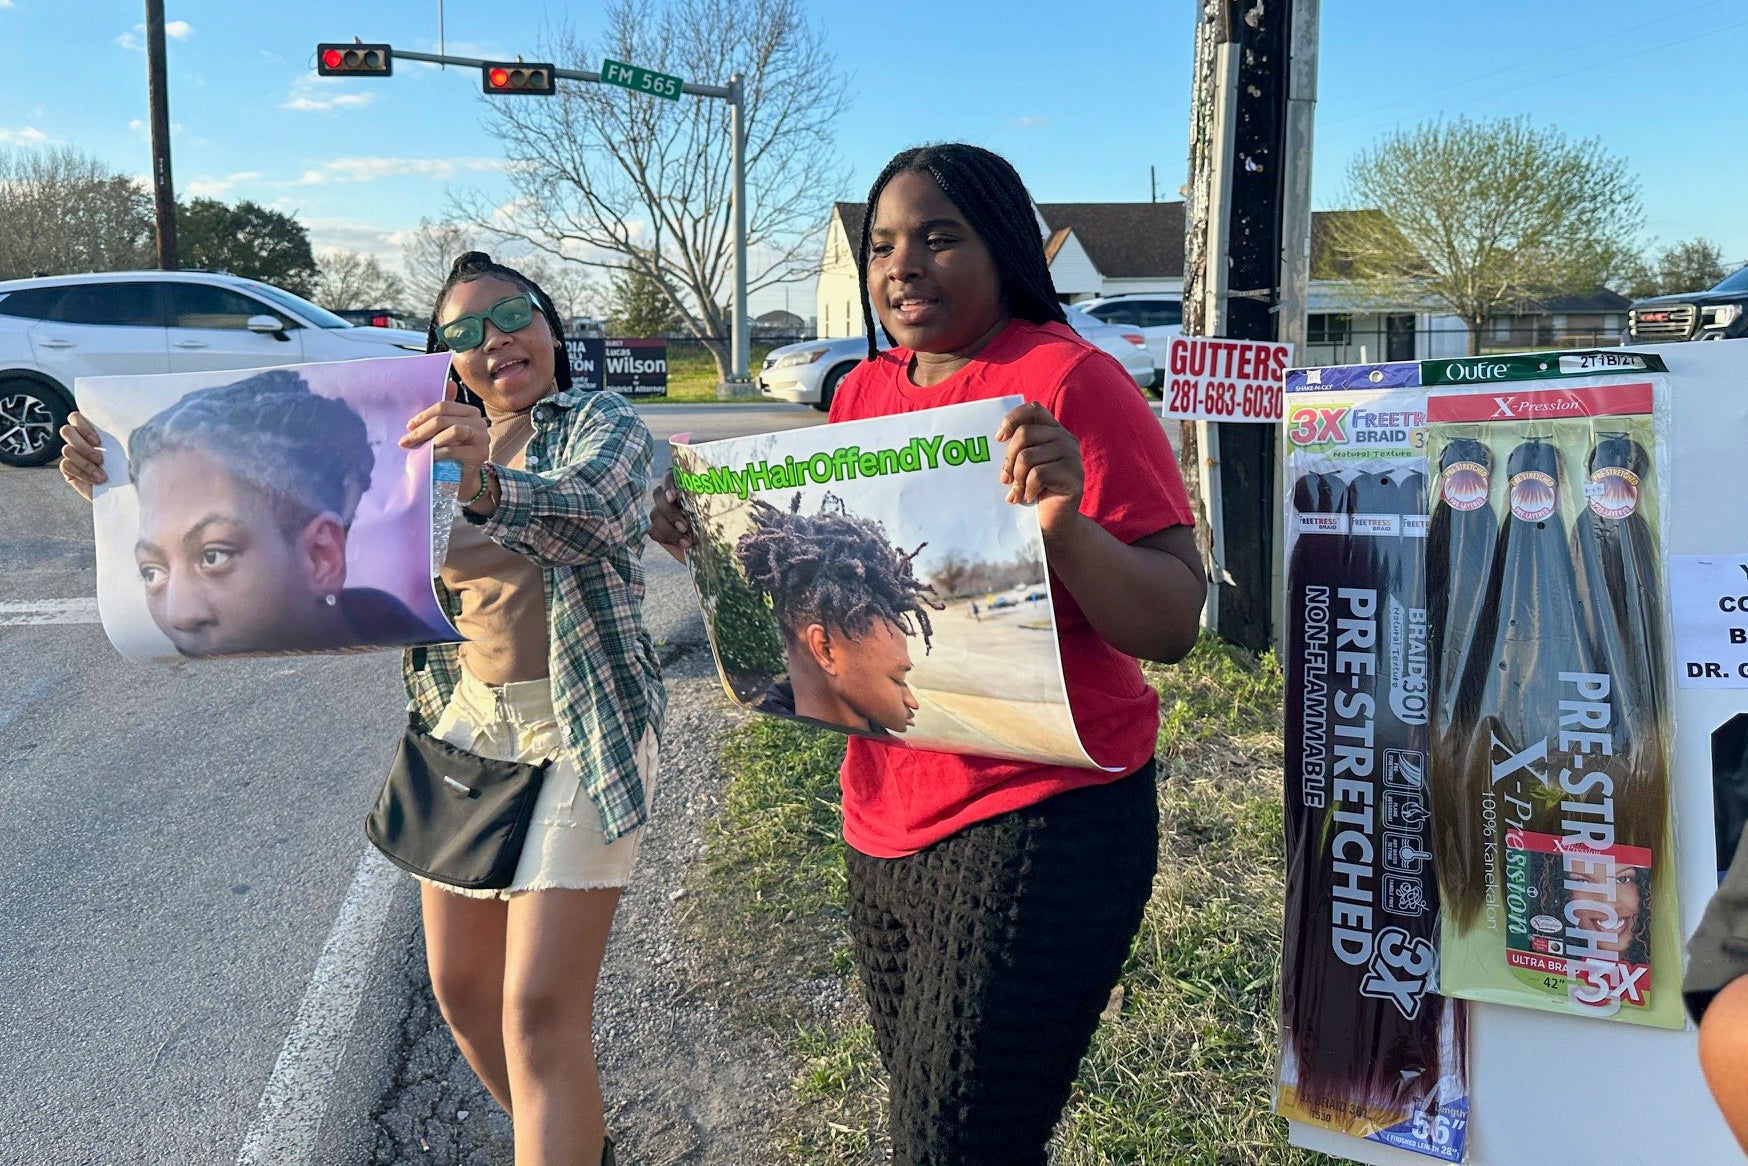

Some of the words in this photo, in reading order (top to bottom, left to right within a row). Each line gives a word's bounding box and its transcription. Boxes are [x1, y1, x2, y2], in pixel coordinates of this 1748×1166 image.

[608, 64, 633, 85] FM
[641, 73, 676, 95] 565
[605, 348, 631, 356] Lucas
[606, 357, 666, 373] Wilson
[1170, 339, 1289, 382] GUTTERS
[634, 385, 666, 393] Attorney
[1168, 379, 1283, 419] 281-683-6030
[1492, 396, 1579, 417] X-Pression
[1290, 407, 1349, 446] 3X
[1355, 430, 1407, 443] BRAID
[1414, 432, 1428, 449] 3
[1407, 608, 1426, 678] BRAID
[1687, 662, 1730, 678] DR.
[1302, 584, 1329, 808] NON-FLAMMABLE
[1402, 680, 1427, 721] 301
[1332, 587, 1377, 965] PRE-STRETCHED
[1482, 791, 1496, 836] 100%
[1490, 730, 1549, 935] X-Pression
[1484, 842, 1499, 929] Kanekalon
[1361, 928, 1432, 1018] 3X
[1512, 954, 1545, 969] ULTRA
[1543, 977, 1565, 989] 42"
